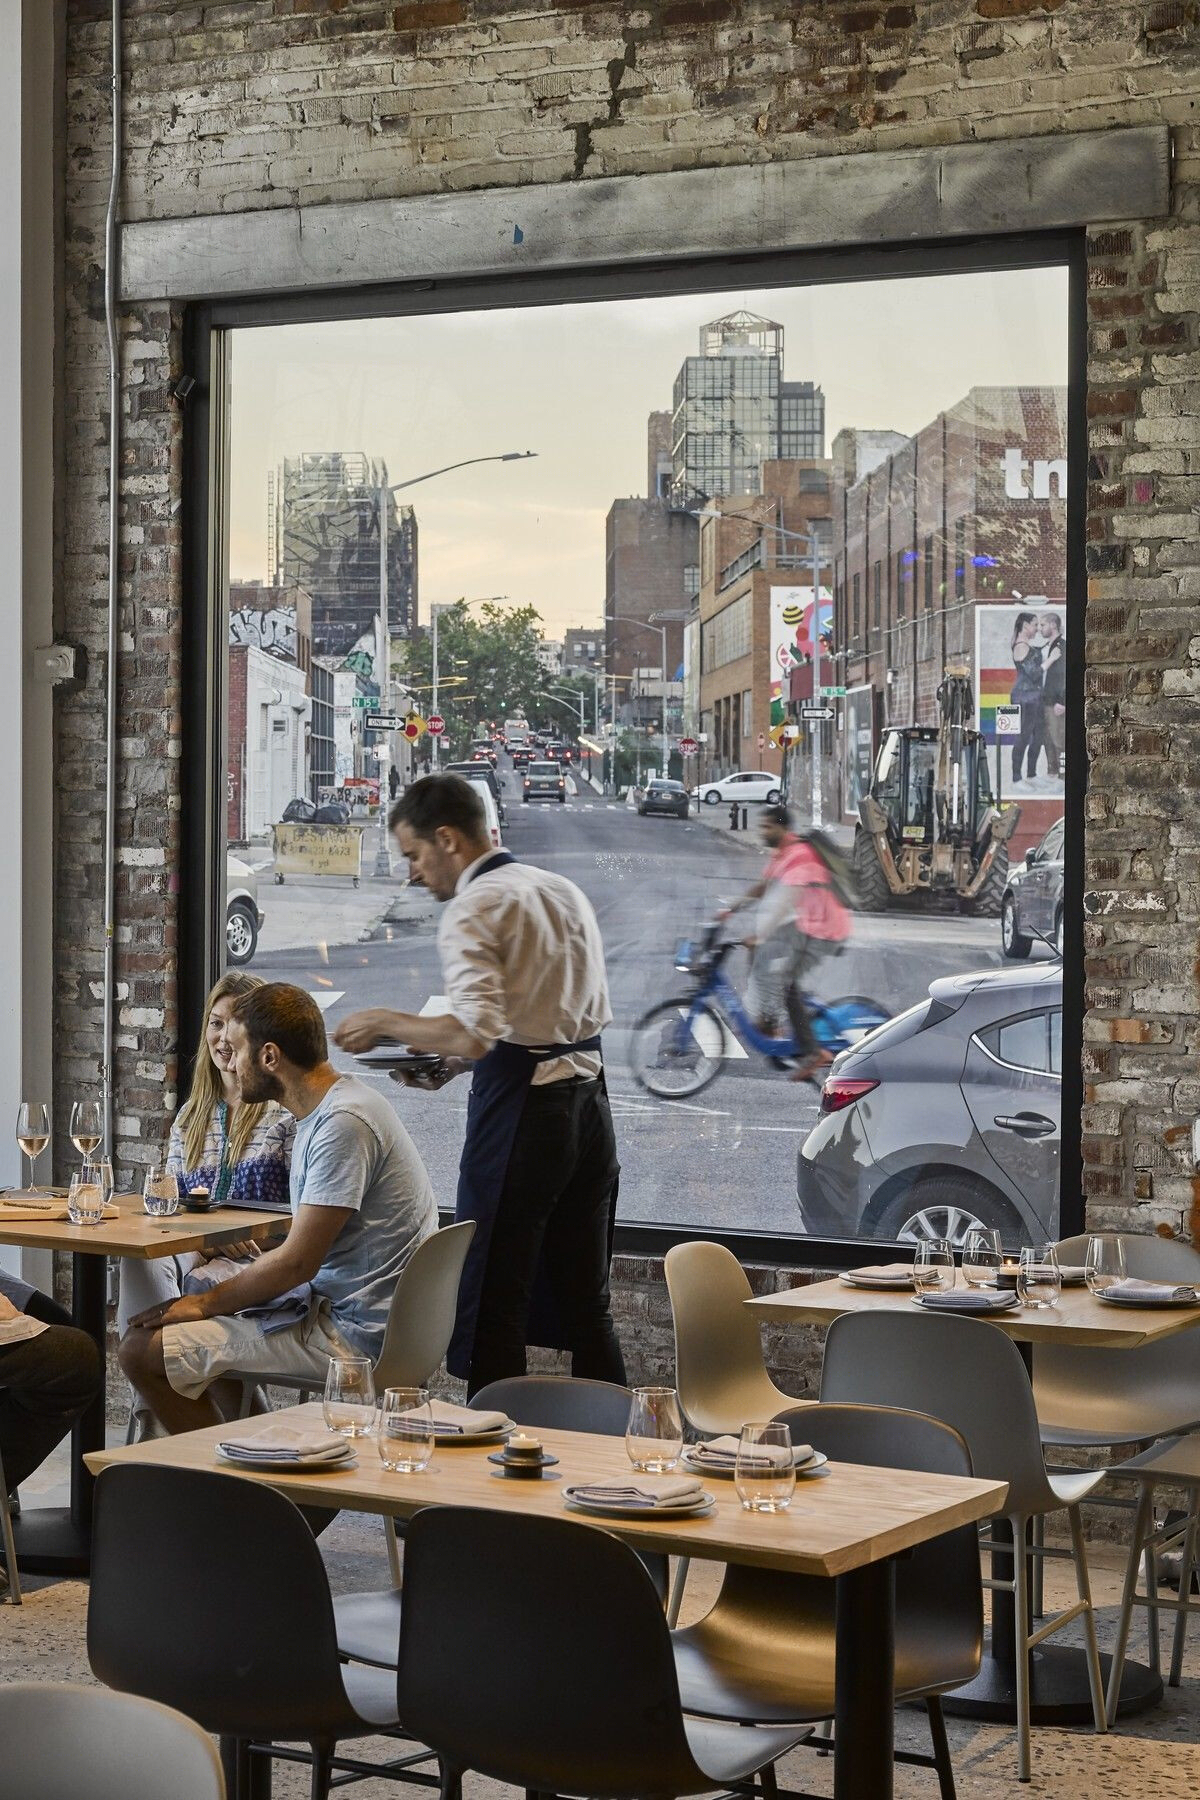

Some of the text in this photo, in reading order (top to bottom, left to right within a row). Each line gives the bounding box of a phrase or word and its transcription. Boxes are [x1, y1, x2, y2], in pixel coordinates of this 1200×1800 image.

[353, 699, 360, 707] N
[363, 699, 371, 707] 15
[427, 720, 445, 729] STOP
